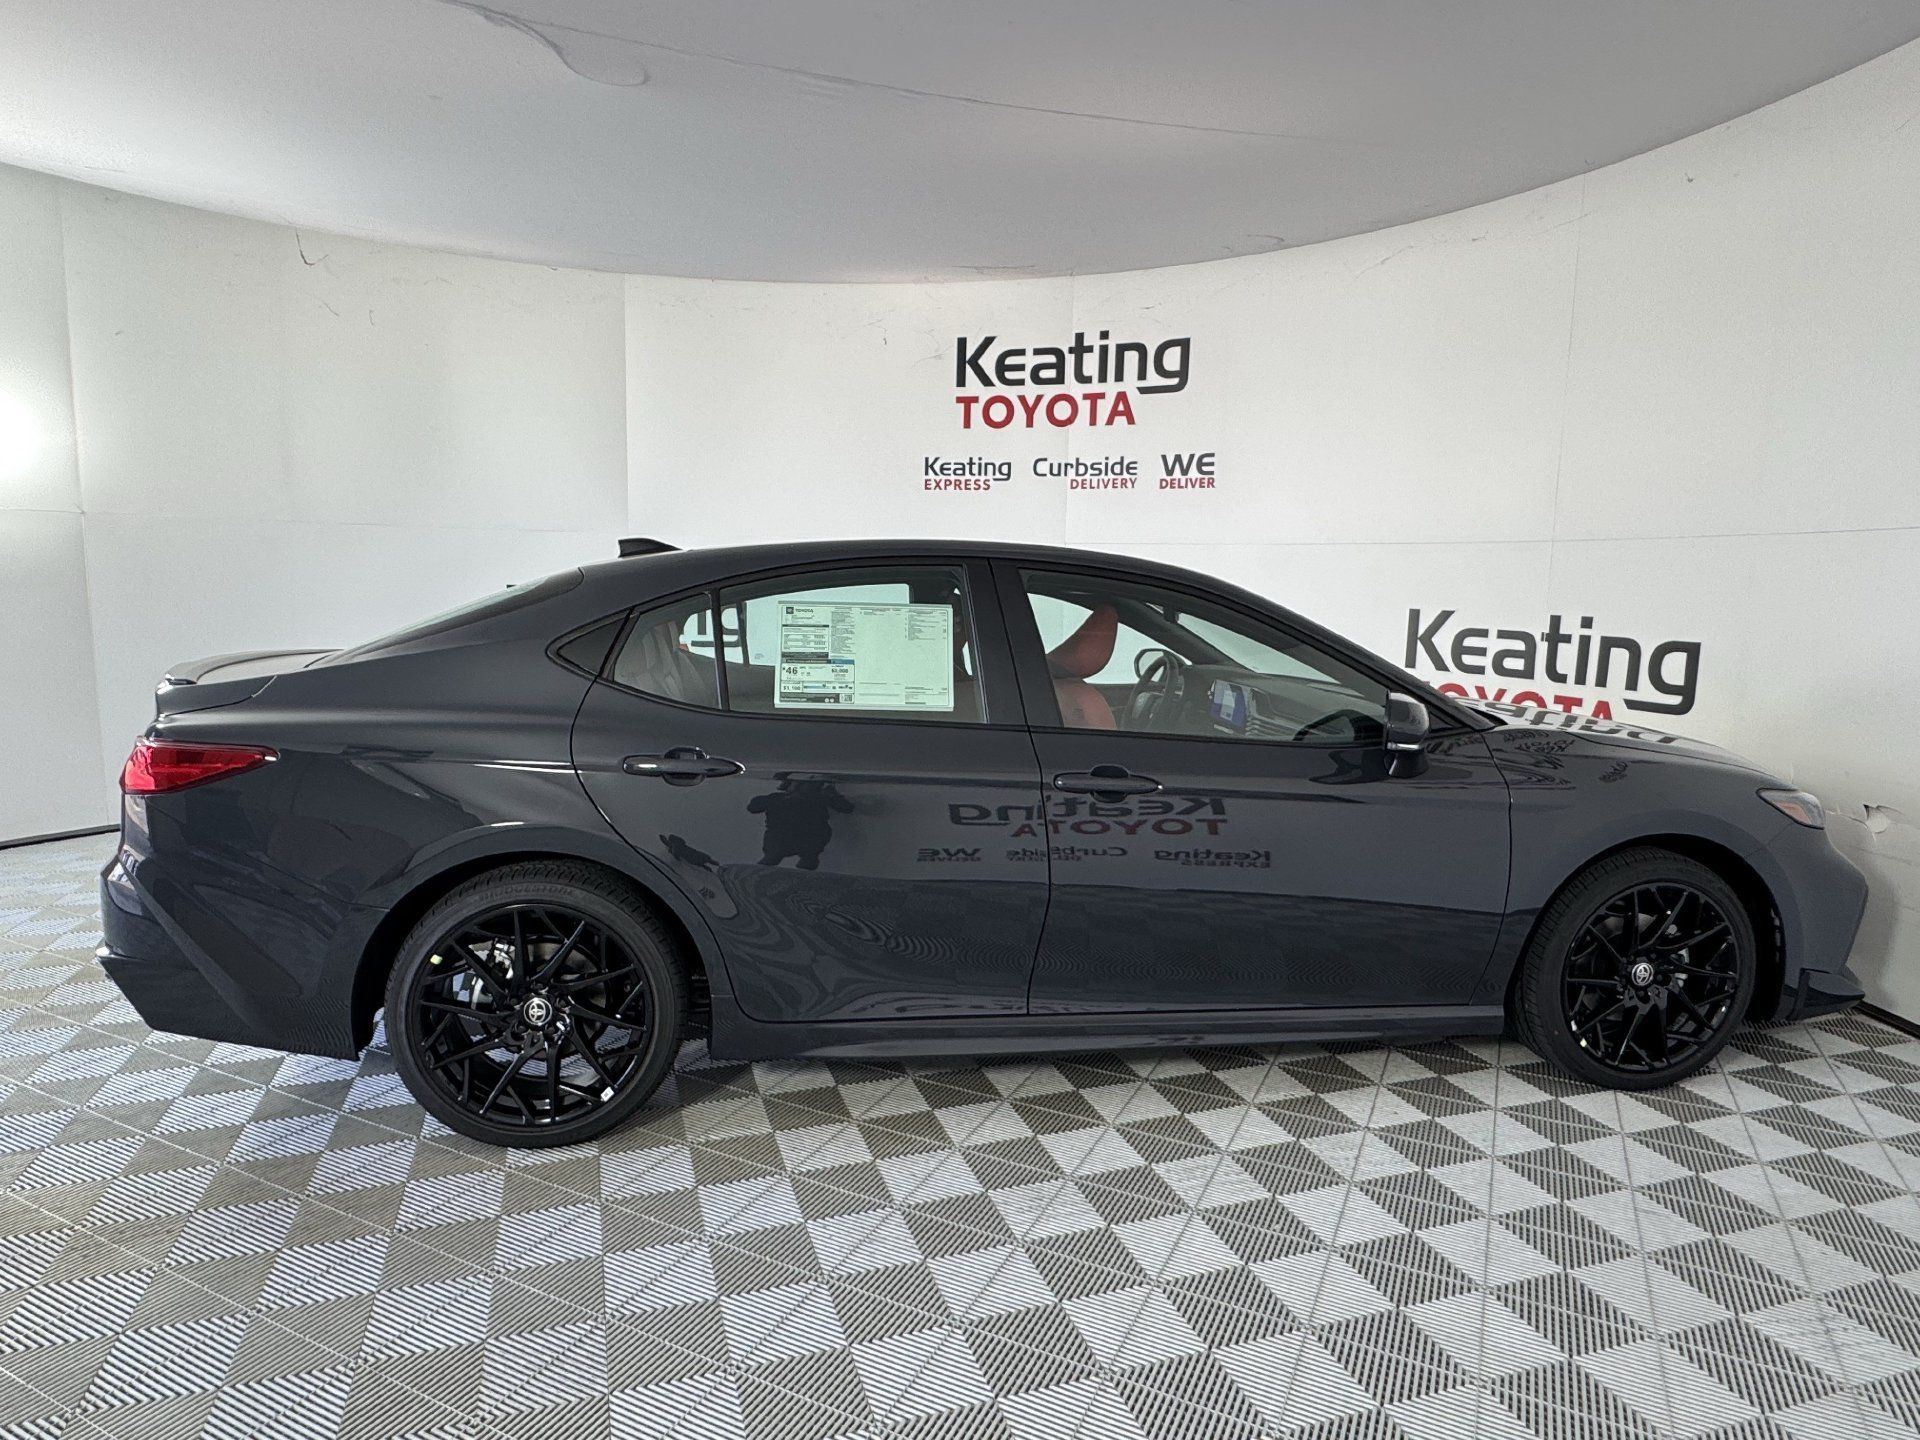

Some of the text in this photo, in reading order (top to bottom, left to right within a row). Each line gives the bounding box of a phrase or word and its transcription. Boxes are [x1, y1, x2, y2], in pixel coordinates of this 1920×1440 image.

[955, 330, 1191, 395] Keating
[955, 391, 1136, 429] TOYOTA
[924, 456, 1012, 481] Keating
[1033, 456, 1138, 478] Curbside
[1160, 453, 1215, 477] WE
[924, 479, 991, 491] EXPRESS
[1070, 477, 1138, 490] DELIVERY
[1159, 477, 1216, 490] DELIVER
[786, 666, 798, 675] 46
[1404, 608, 1702, 716] Keating
